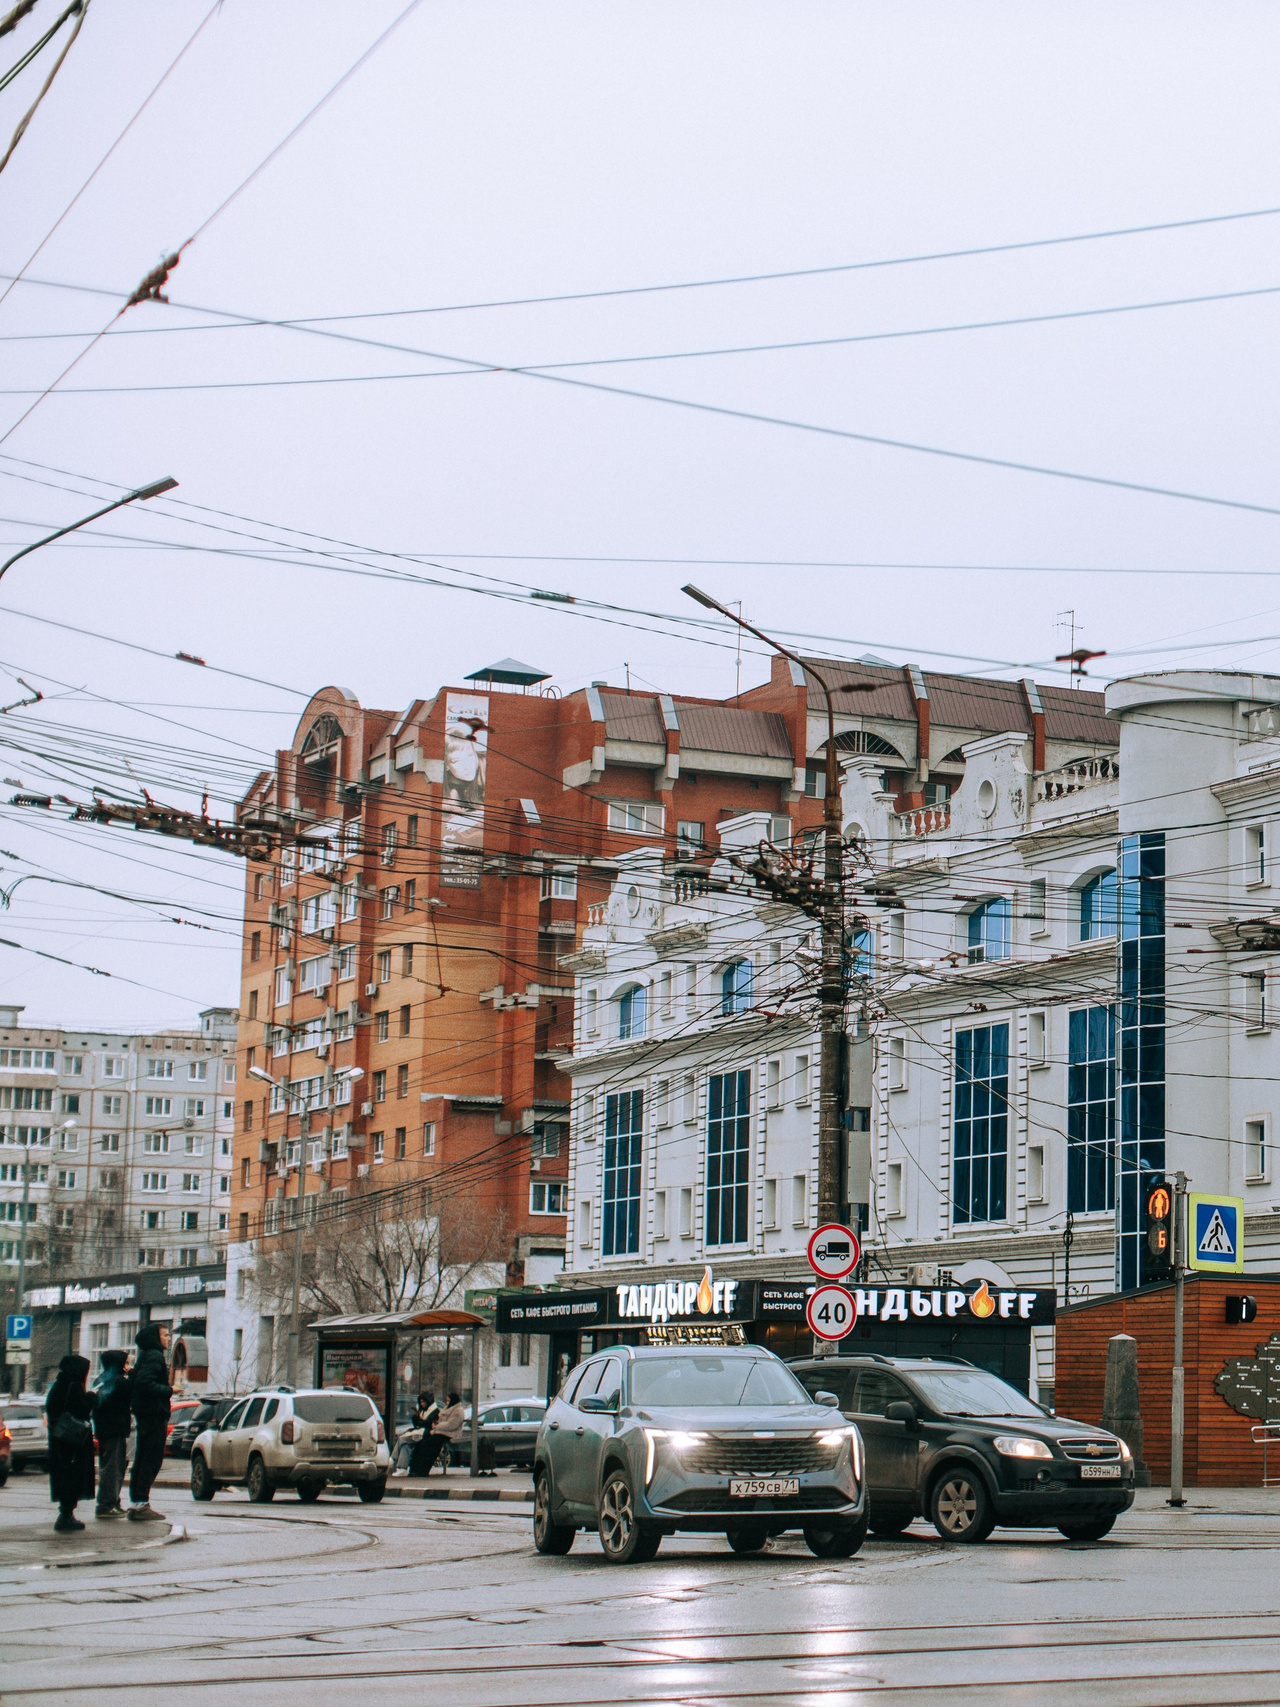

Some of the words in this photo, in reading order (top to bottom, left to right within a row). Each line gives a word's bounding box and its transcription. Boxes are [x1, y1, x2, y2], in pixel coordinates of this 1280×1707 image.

[1158, 1230, 1166, 1249] 6
[763, 1291, 782, 1299] СЕТЬ
[783, 1291, 804, 1299] КАФЕ
[510, 1308, 524, 1319] СЕТЬ
[525, 1307, 541, 1318] КАФЕ
[541, 1304, 571, 1317] БЫСТРОГО
[571, 1302, 598, 1315] ПИТАНИЯ
[763, 1303, 803, 1311] БЫСТРОГО
[817, 1302, 847, 1324] 40
[13, 1317, 28, 1337] P
[735, 1481, 781, 1494] Х759СВ
[783, 1480, 796, 1490] 71
